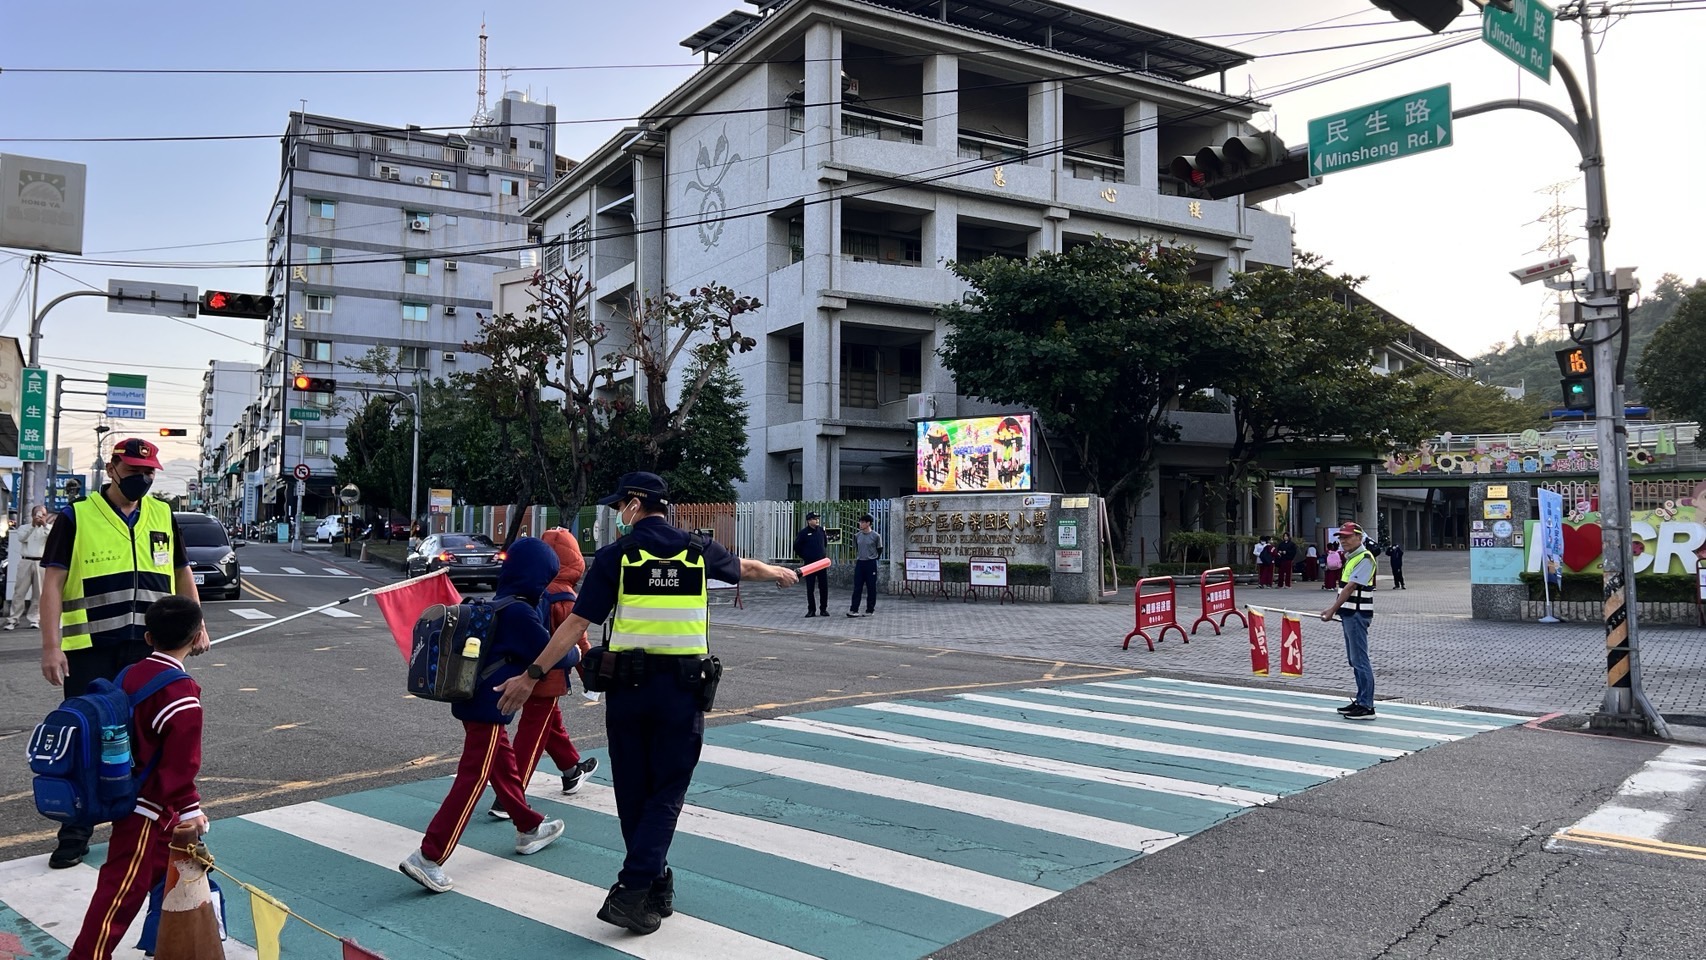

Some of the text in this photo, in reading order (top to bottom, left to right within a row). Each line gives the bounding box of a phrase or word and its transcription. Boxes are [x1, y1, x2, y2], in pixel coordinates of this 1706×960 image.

[1500, 0, 1546, 43] 州路
[1491, 21, 1545, 71] Jinzhou Rd.
[1325, 99, 1431, 145] 民生路
[1325, 130, 1433, 168] Minsheng Rd.
[21, 198, 46, 207] HONG
[1568, 349, 1588, 374] 16
[108, 390, 145, 398] FamilyMart
[24, 381, 43, 442] 民生路
[1474, 538, 1494, 548] 156
[648, 578, 680, 587] POLICE
[651, 568, 679, 578] 警察
